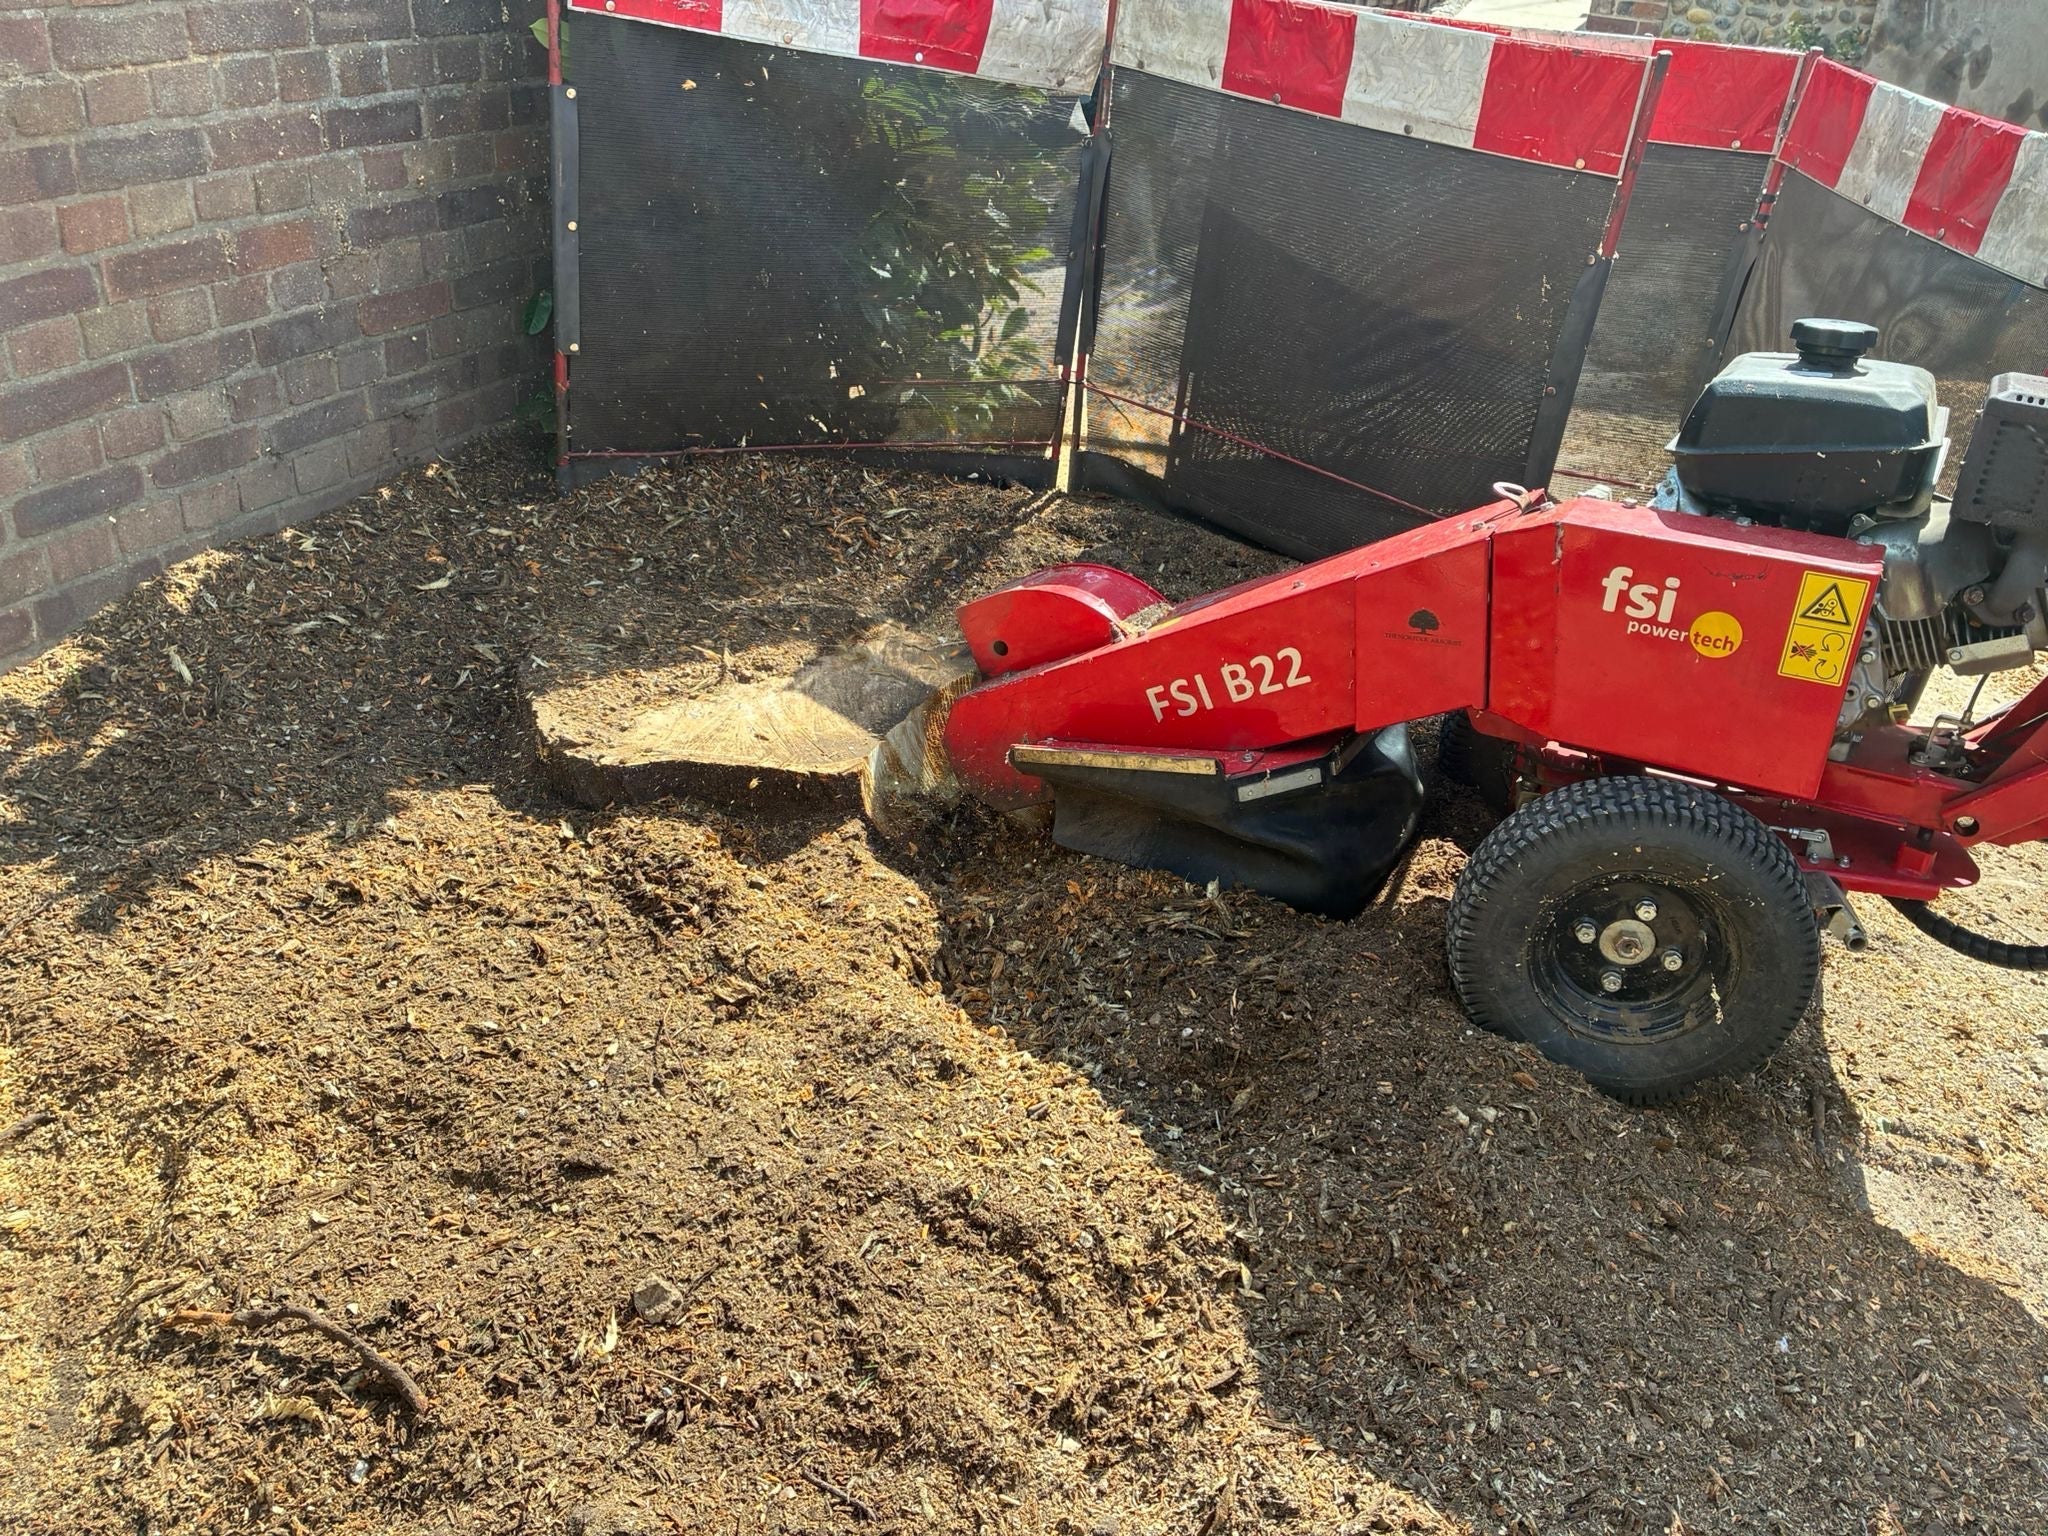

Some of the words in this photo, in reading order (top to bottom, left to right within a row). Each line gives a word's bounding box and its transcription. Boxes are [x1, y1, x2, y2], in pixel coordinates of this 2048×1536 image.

[1601, 566, 1681, 624] fsi
[1626, 620, 1689, 642] power
[1693, 631, 1735, 652] tech
[1145, 673, 1214, 723] FSI
[1220, 647, 1312, 703] B22
